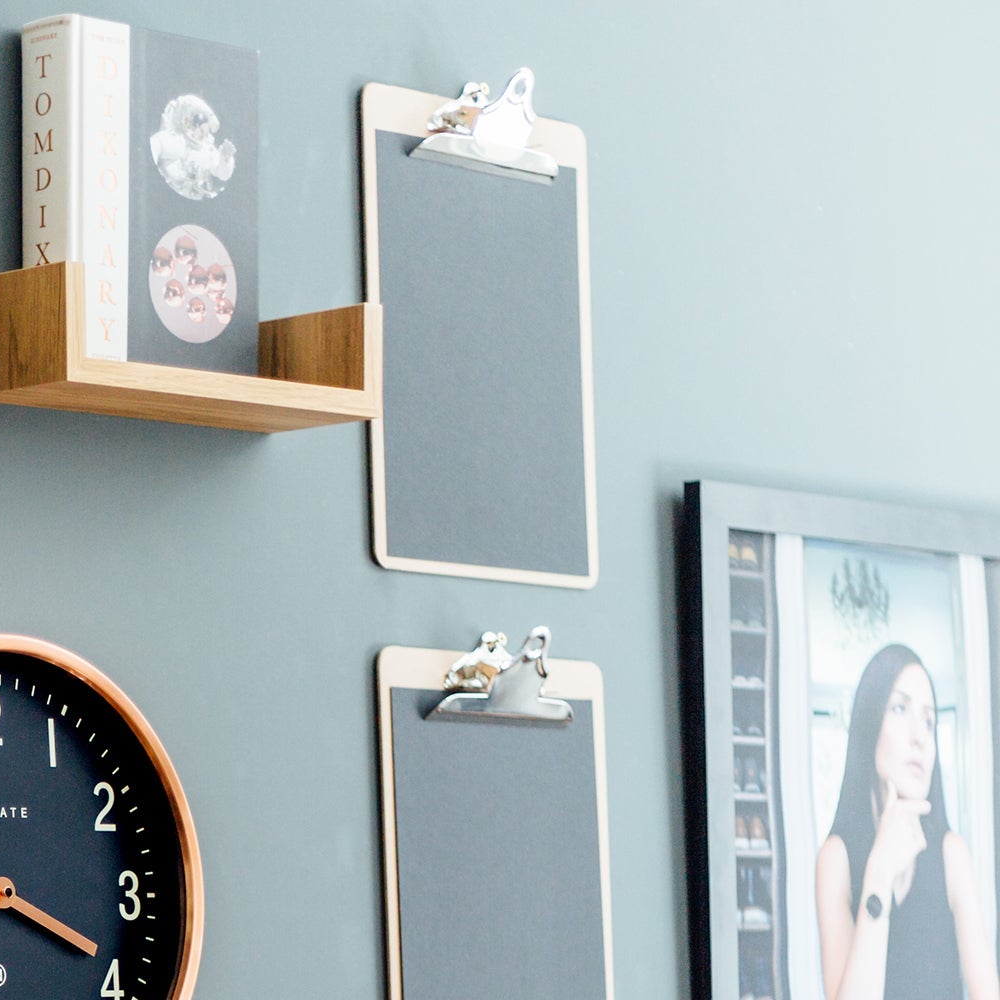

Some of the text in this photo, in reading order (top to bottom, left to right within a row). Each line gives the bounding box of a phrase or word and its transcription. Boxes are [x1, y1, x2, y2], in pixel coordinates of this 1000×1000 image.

[98, 57, 118, 343] DIXONARY
[48, 719, 56, 767] 1
[94, 782, 116, 831] 2
[119, 871, 140, 920] 3
